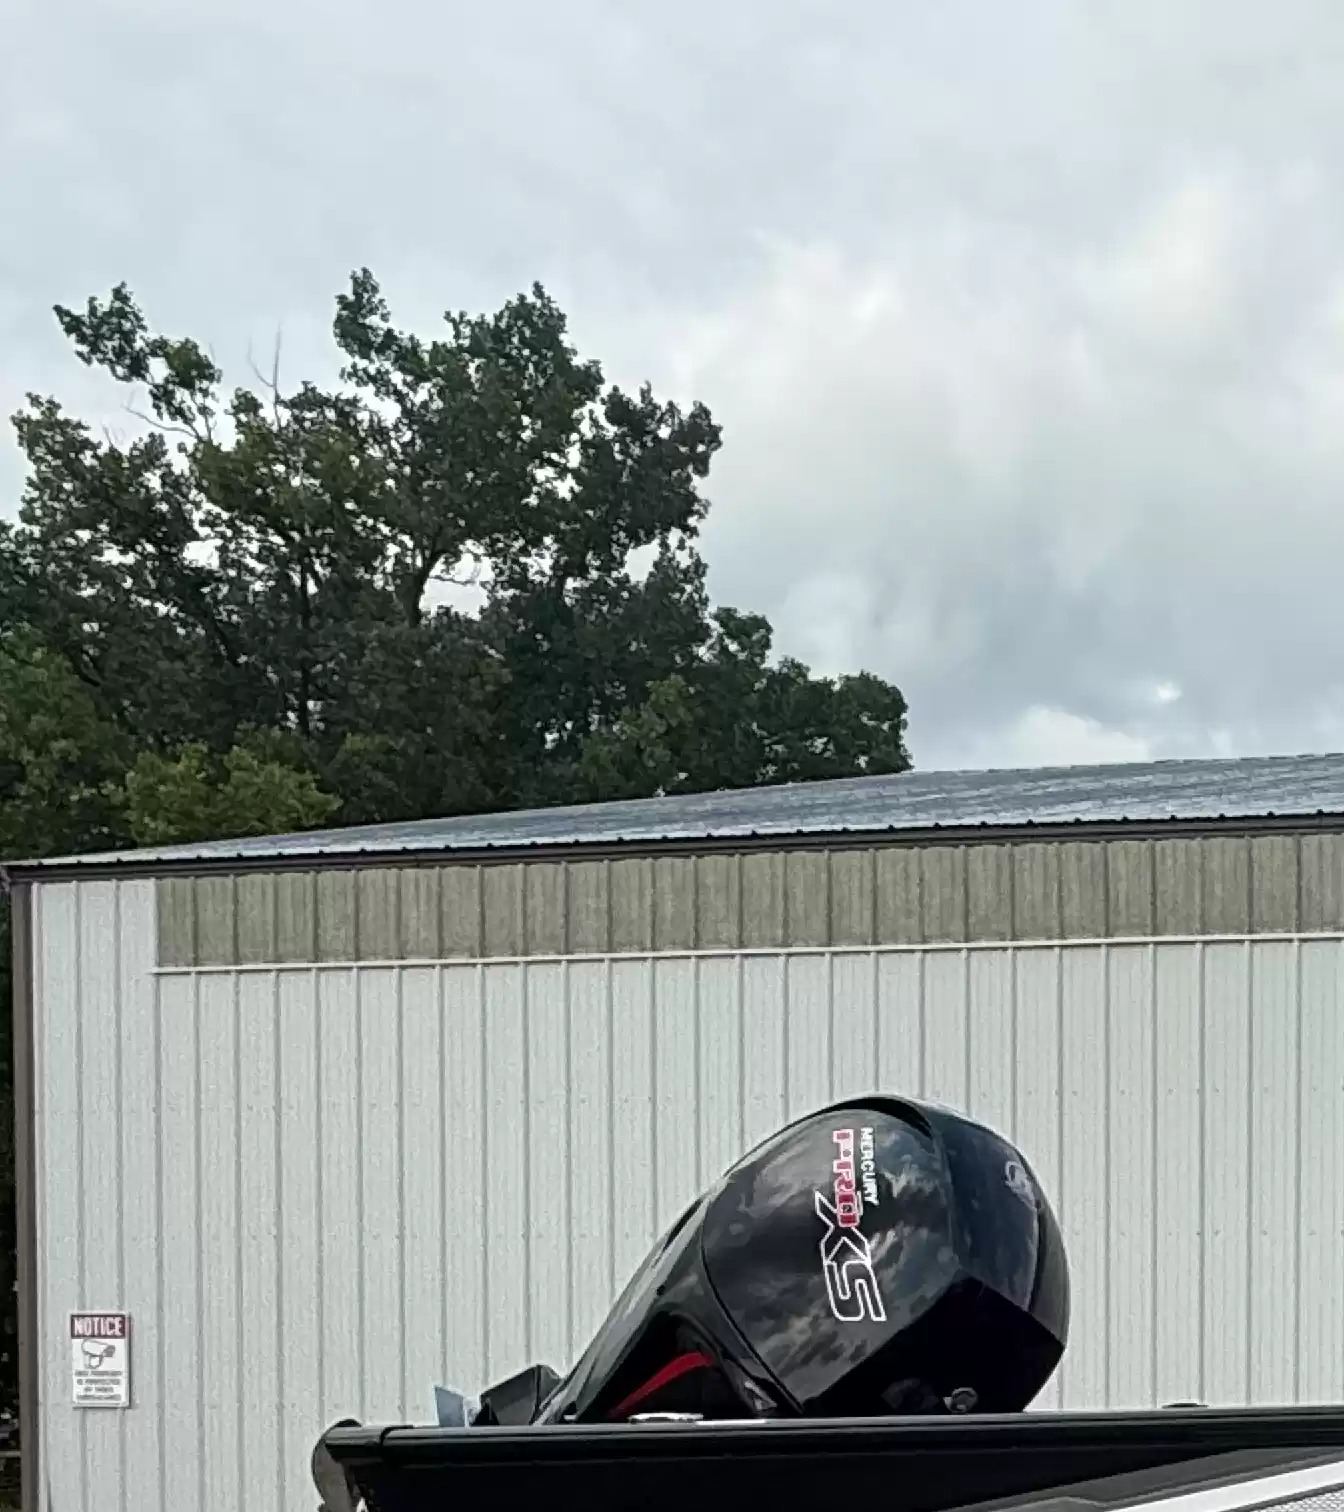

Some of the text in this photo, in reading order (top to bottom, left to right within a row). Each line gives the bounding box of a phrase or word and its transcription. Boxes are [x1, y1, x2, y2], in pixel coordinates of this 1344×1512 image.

[860, 1126, 880, 1206] MERCURY
[813, 1128, 888, 1323] PRO XS
[74, 1316, 122, 1336] NOTICE
